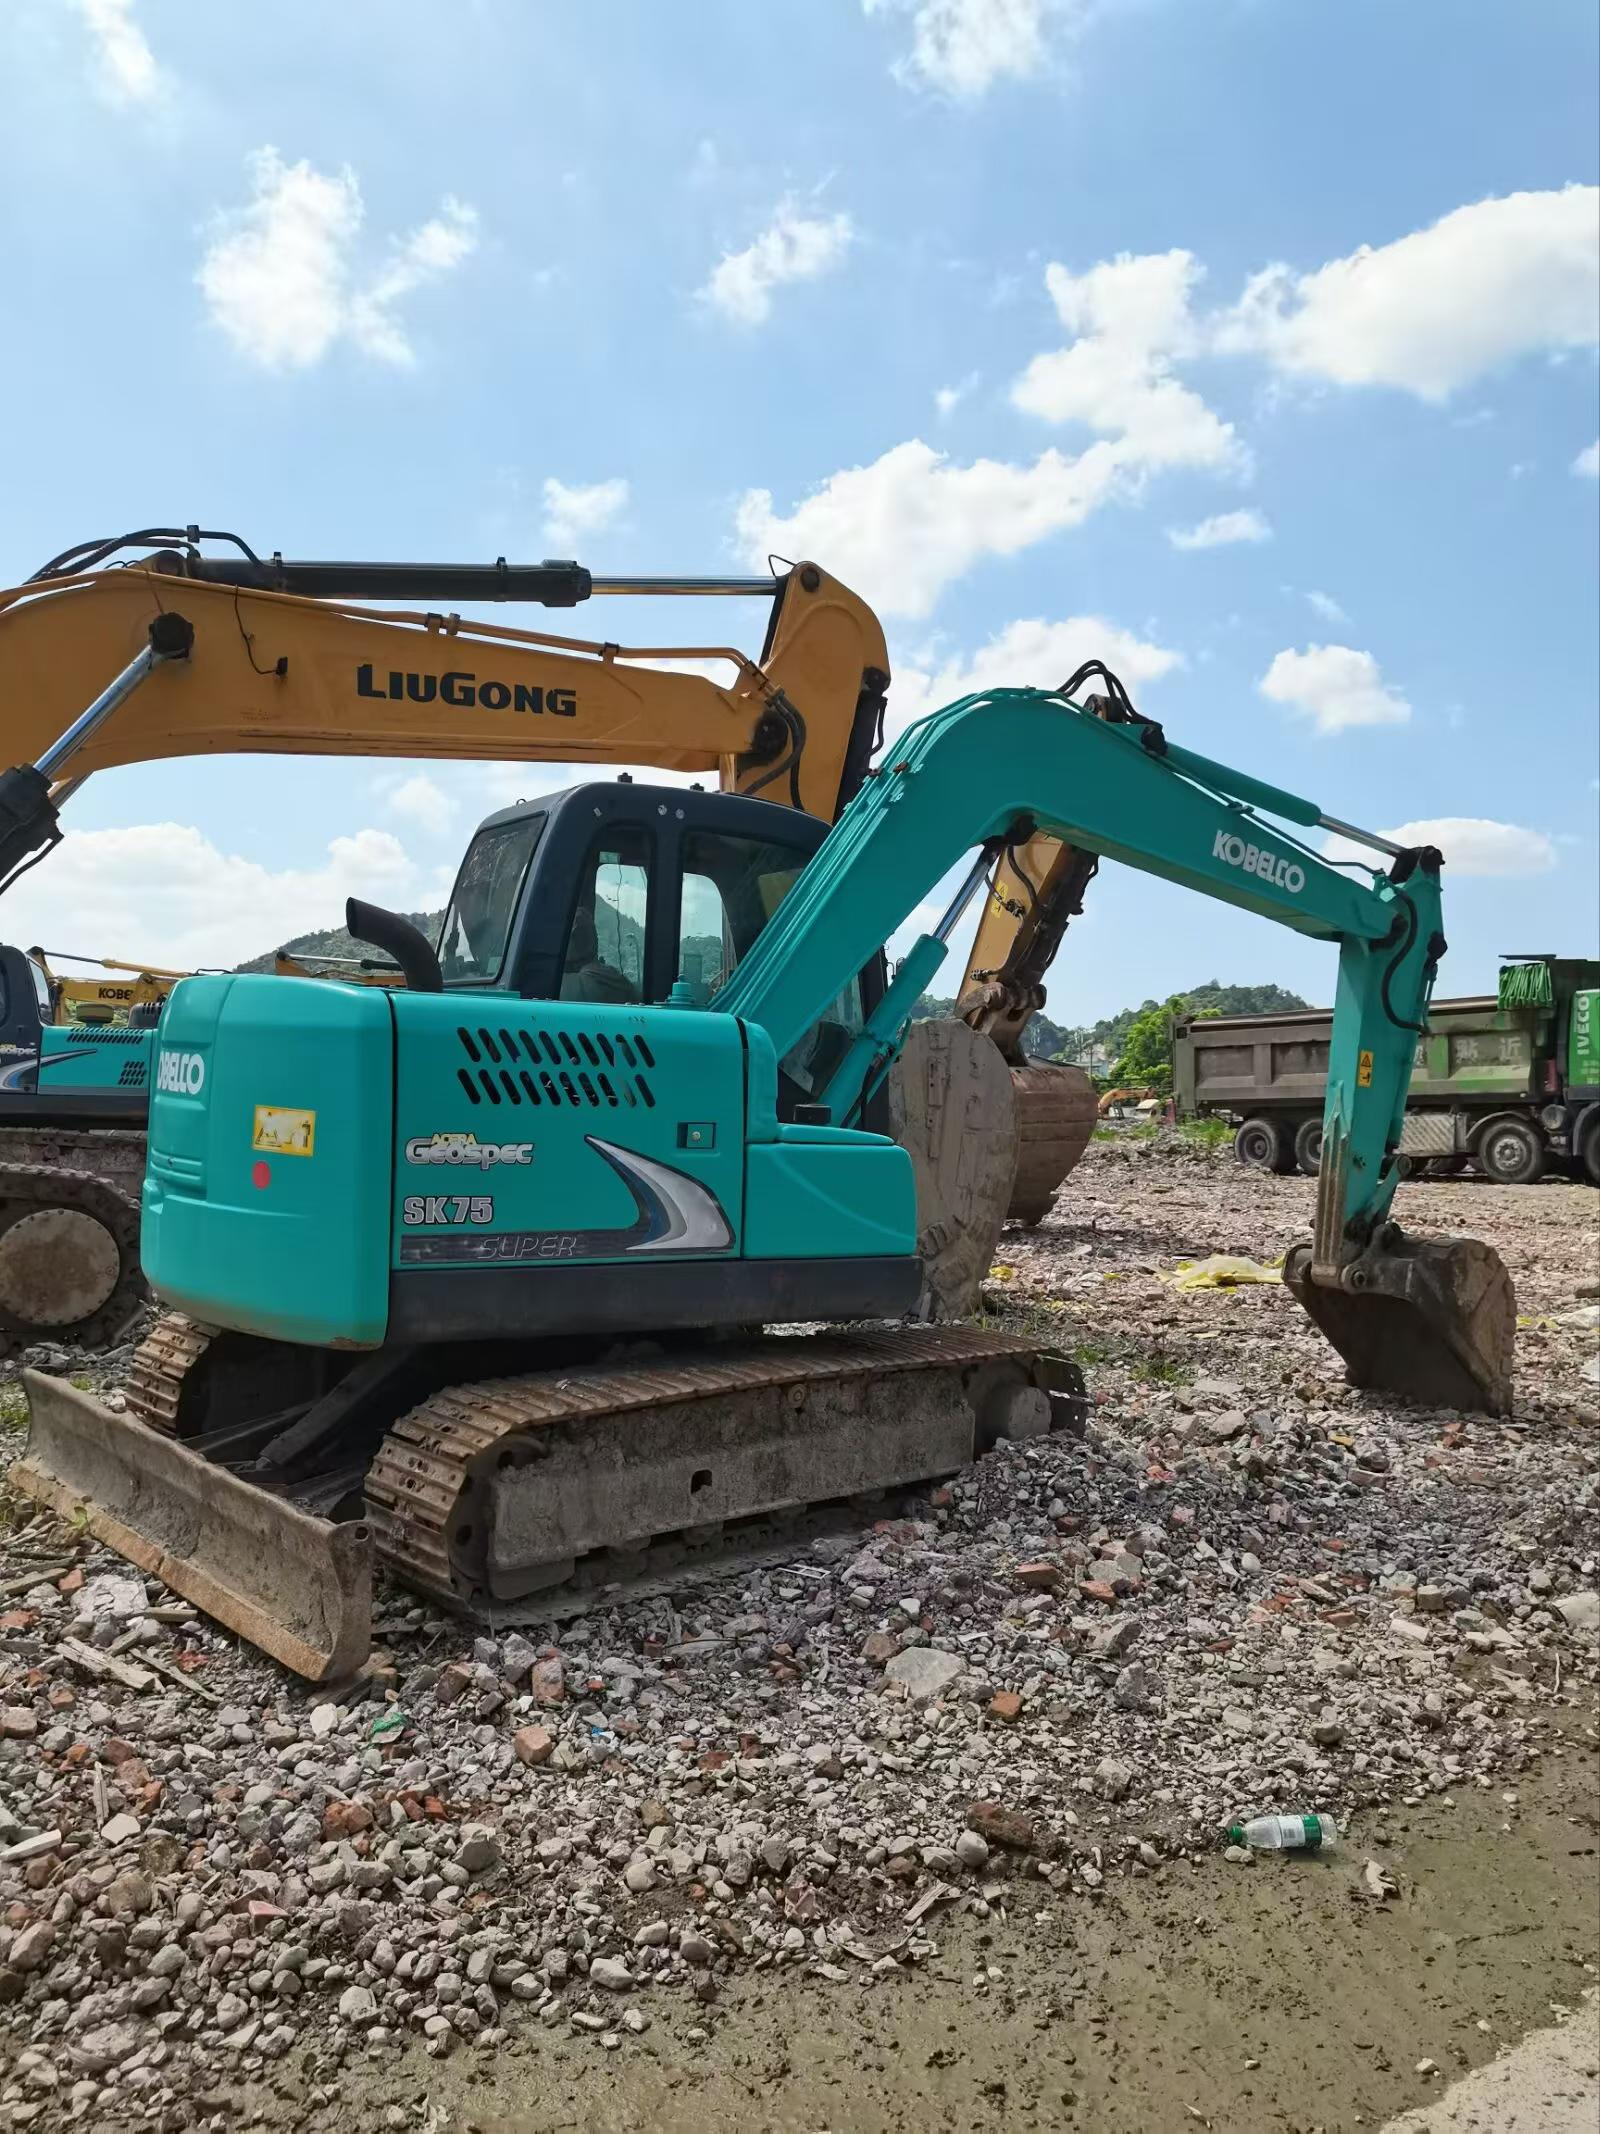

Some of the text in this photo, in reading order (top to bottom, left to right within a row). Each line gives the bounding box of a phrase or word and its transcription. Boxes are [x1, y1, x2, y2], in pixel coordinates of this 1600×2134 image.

[1212, 829, 1306, 894] KOBELCO
[1577, 995, 1590, 1055] IVECO
[403, 1196, 494, 1225] SK75
[477, 1235, 578, 1259] SUPER
